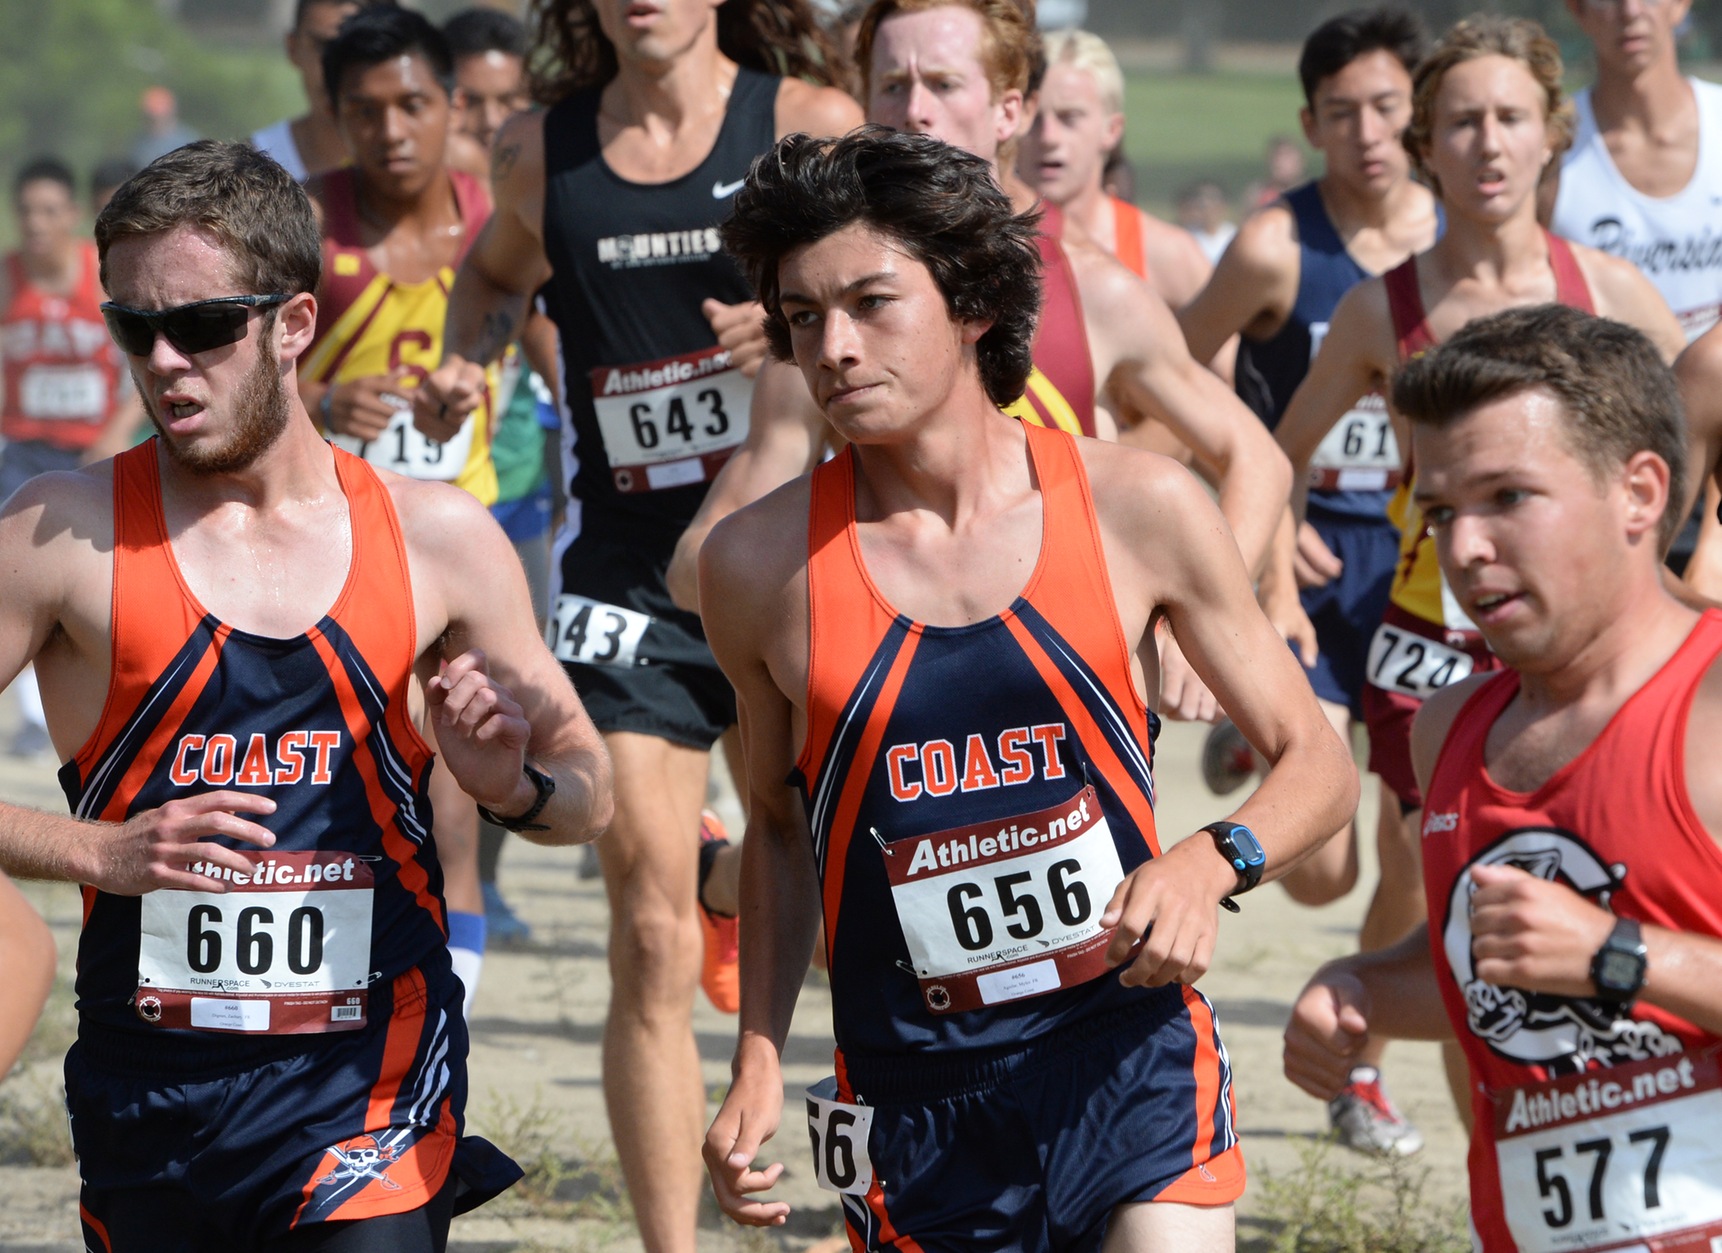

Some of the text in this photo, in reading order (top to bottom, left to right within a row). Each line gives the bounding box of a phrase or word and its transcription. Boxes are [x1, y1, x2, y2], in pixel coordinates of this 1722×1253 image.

[629, 388, 729, 449] 643
[1374, 632, 1458, 690] 724
[169, 731, 341, 786] COAST
[886, 723, 1066, 802] COAST
[186, 858, 355, 885] thletic.net
[906, 798, 1090, 876] Athletic.net
[187, 904, 325, 975] 660
[946, 858, 1092, 951] 656
[190, 977, 250, 988] RUNNERSPACE
[1505, 1056, 1696, 1133] Athletic.net
[1535, 1126, 1671, 1229] 577
